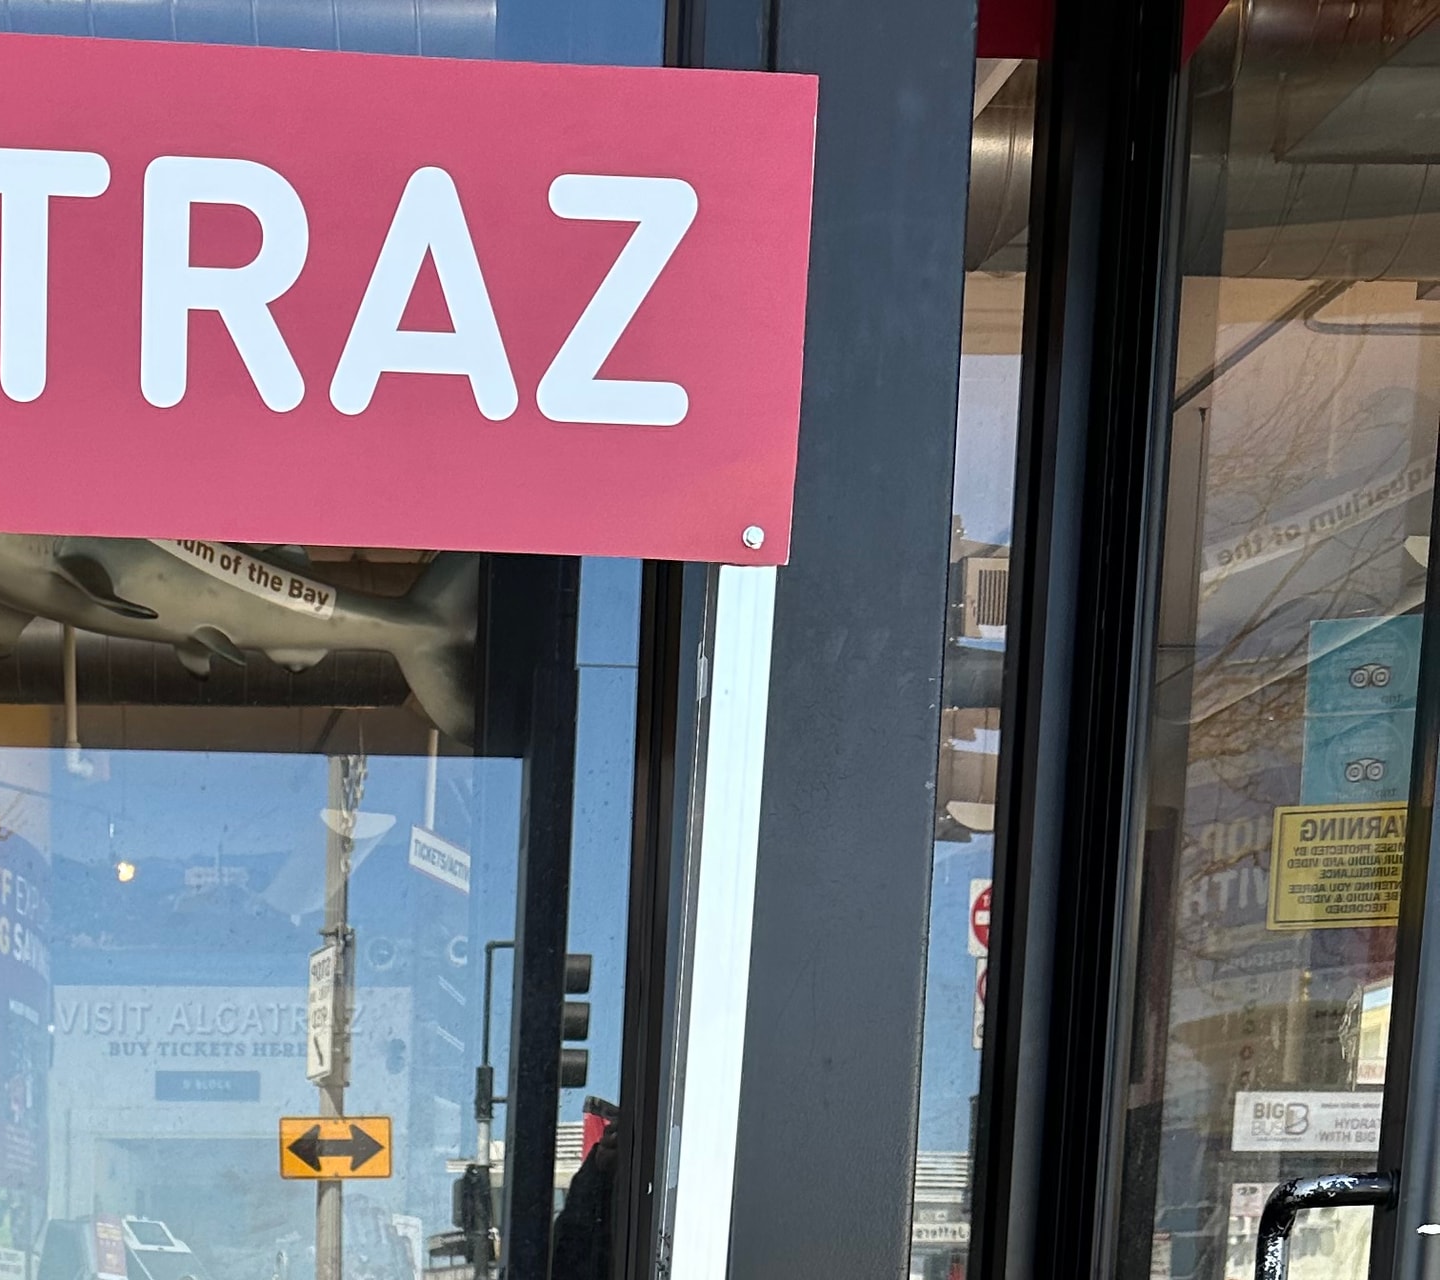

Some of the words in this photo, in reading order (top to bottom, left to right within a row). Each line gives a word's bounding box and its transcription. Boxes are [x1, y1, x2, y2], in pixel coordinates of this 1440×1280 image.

[220, 551, 243, 575] of
[248, 562, 283, 592] the
[288, 578, 330, 612] Bay
[59, 1002, 152, 1036] VISIT
[167, 1003, 364, 1036] ALCATRZ
[109, 1041, 157, 1059] BUY
[158, 1041, 248, 1058] TICKETS
[251, 1041, 309, 1058] HERE
[1253, 1102, 1284, 1119] BIG
[1251, 1121, 1284, 1137] BUS
[1355, 1131, 1376, 1142] BIG
